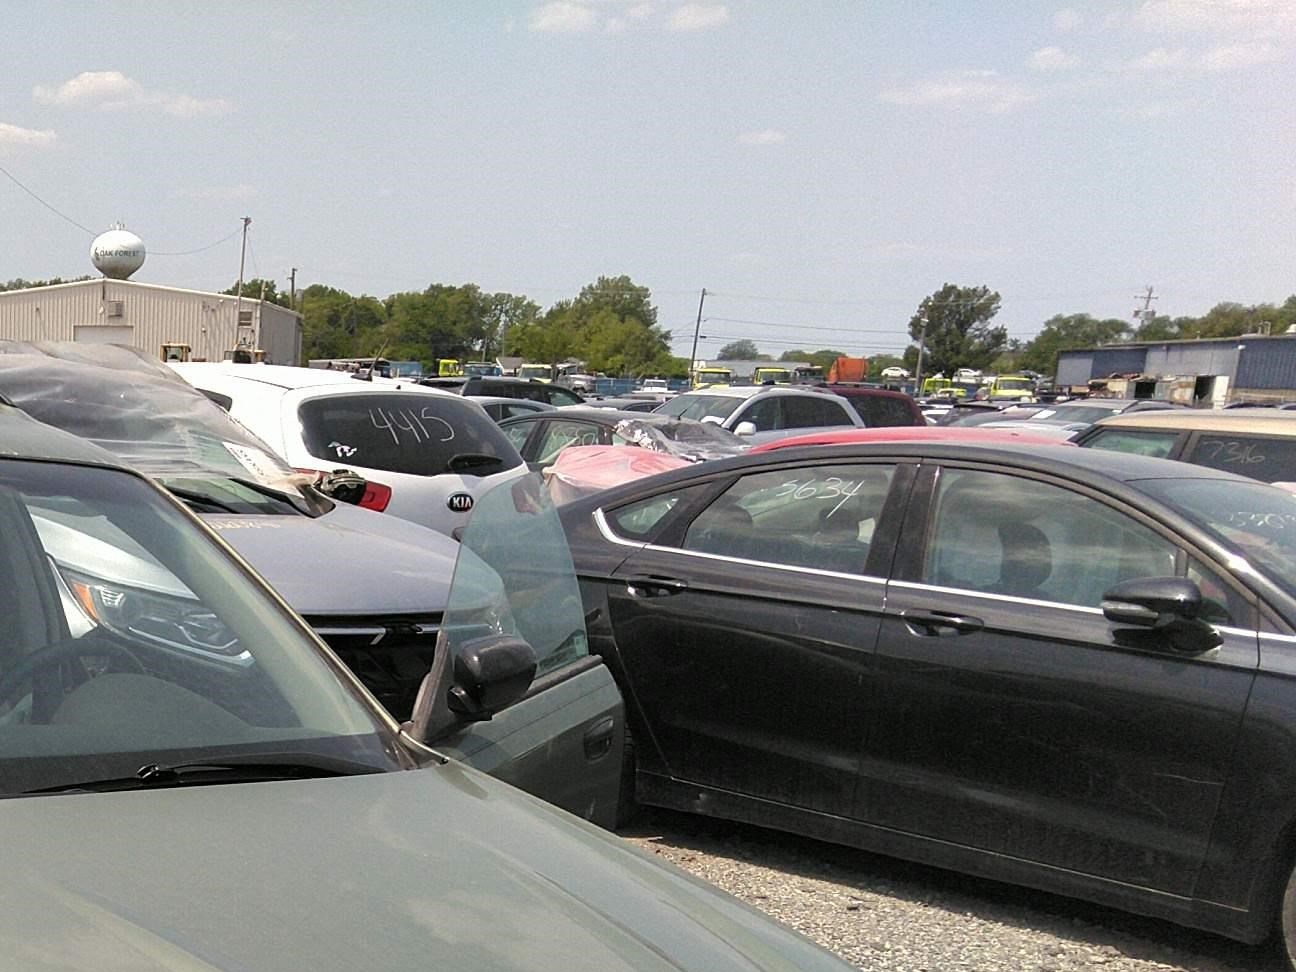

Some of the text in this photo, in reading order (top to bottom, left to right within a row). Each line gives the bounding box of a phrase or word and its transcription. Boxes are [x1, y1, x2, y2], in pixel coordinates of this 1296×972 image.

[99, 249, 112, 257] OAK
[368, 407, 455, 445] 4415
[452, 496, 472, 508] KIA
[775, 477, 865, 519] 5634
